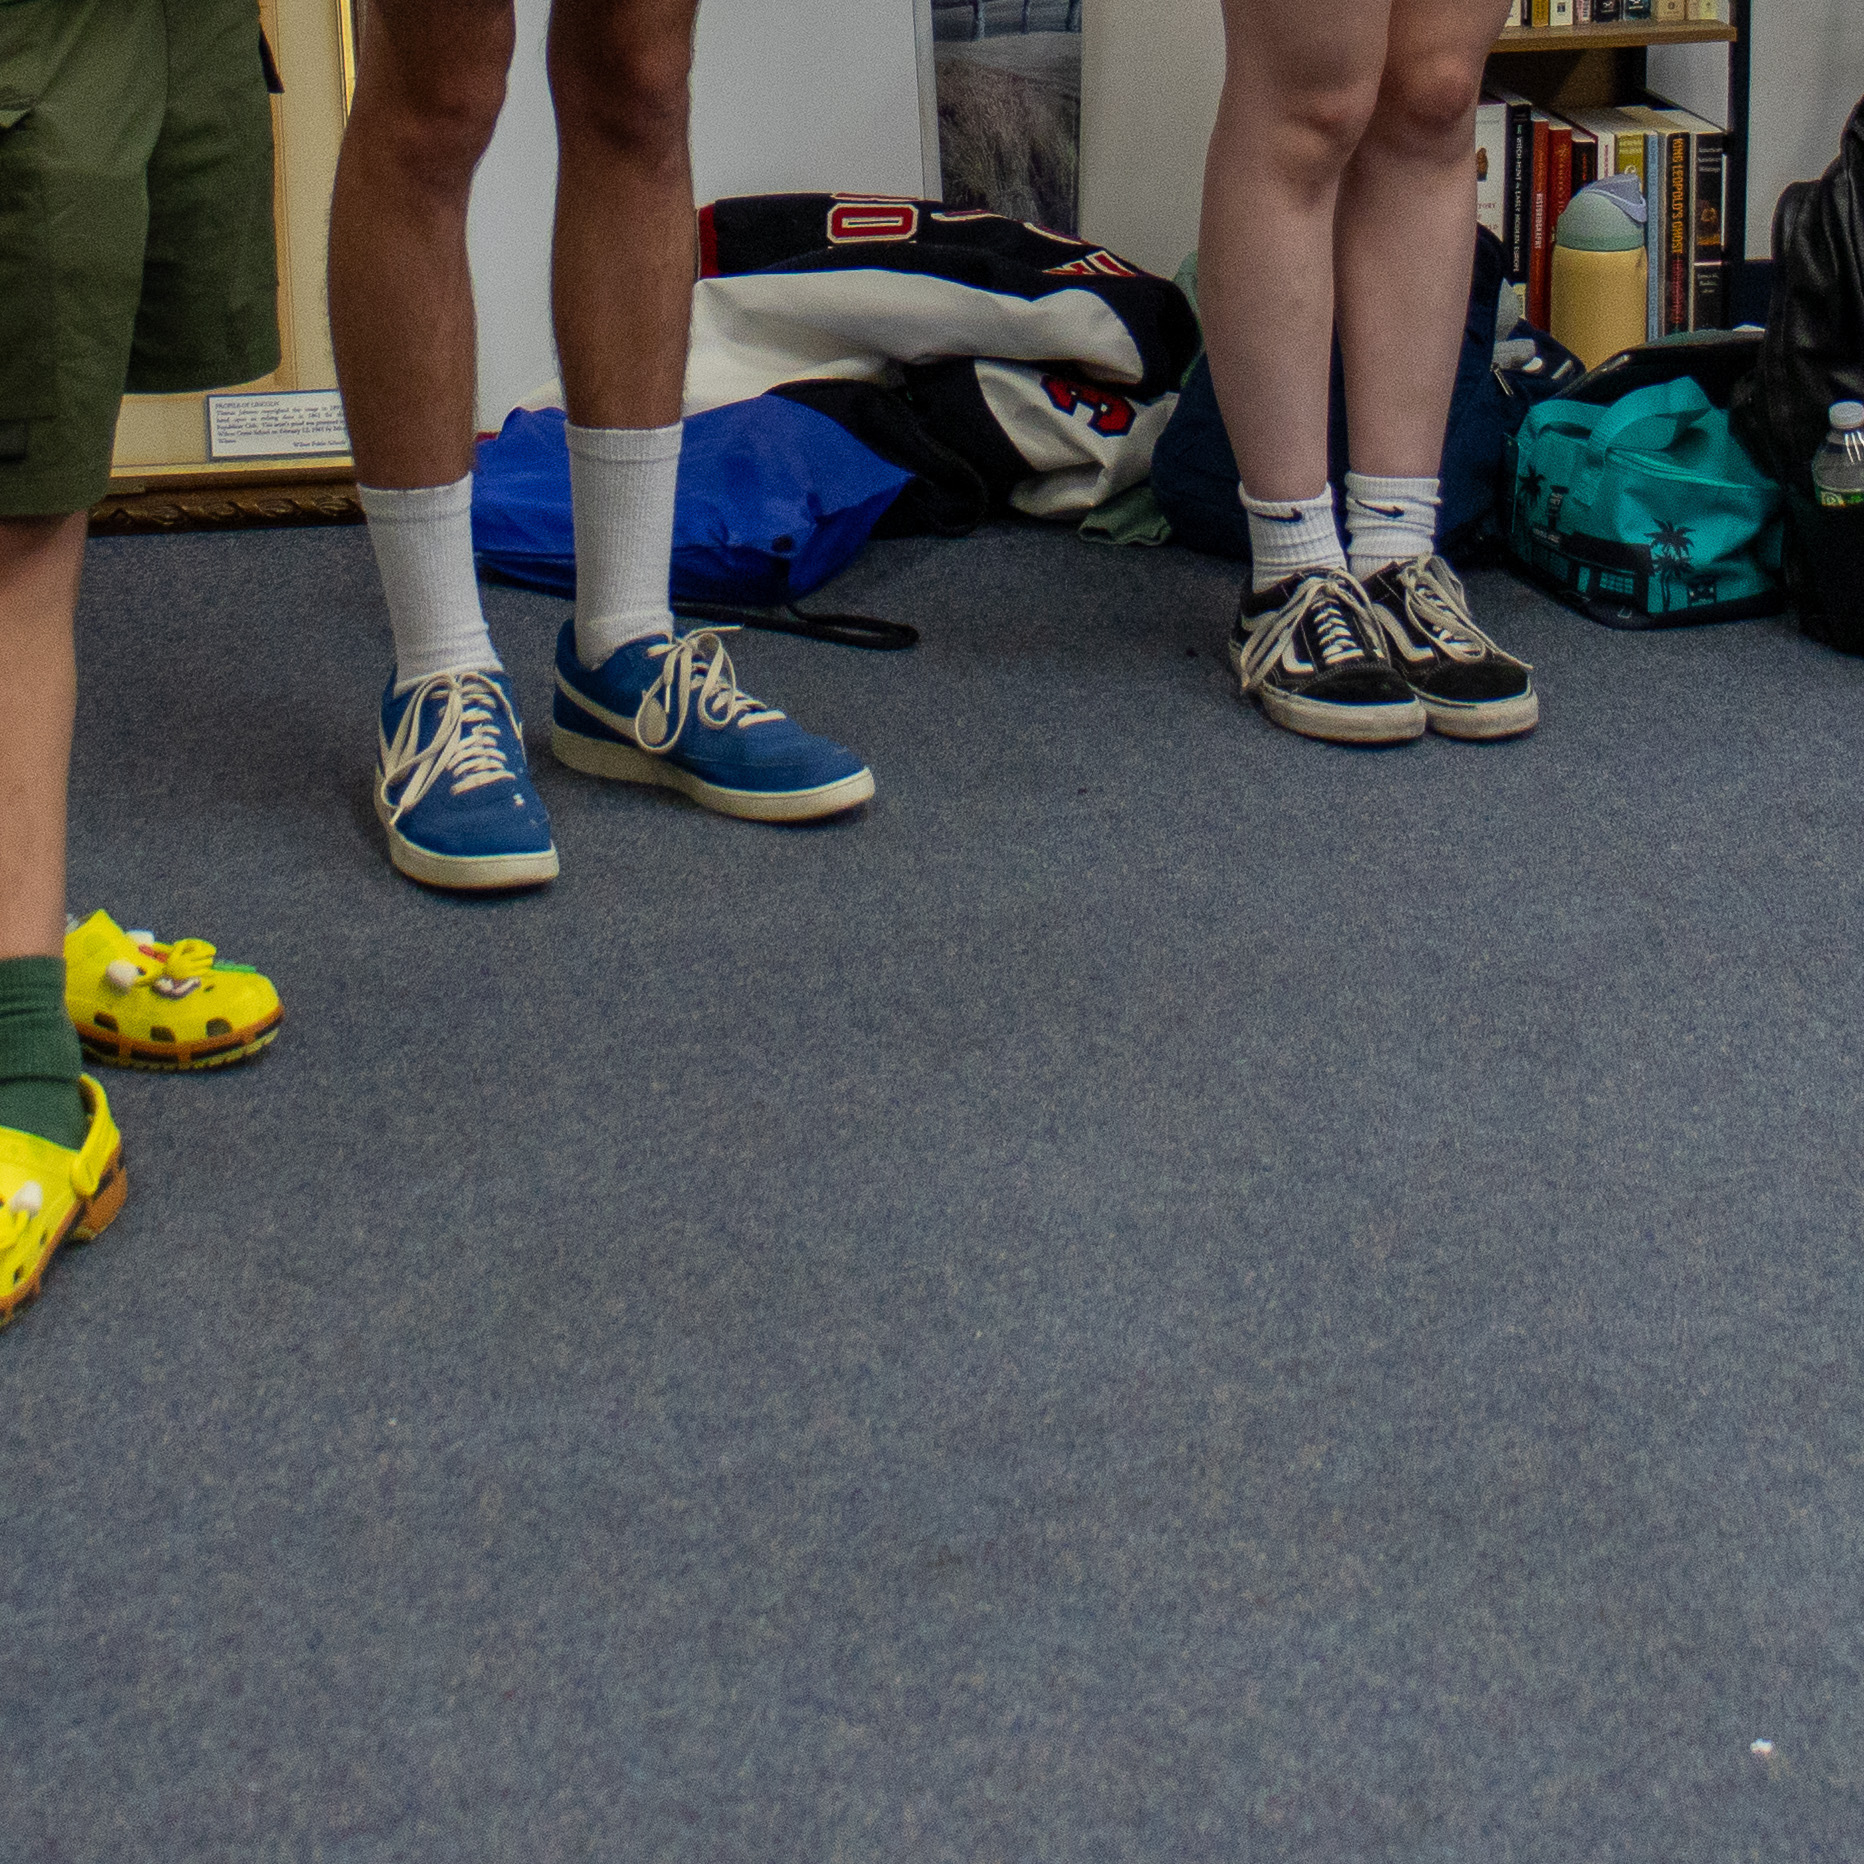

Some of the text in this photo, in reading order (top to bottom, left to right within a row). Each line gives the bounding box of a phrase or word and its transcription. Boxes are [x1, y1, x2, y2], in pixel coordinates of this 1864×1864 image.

[1672, 138, 1683, 163] KING
[1672, 165, 1683, 219] LEOPOLD'S
[1672, 221, 1683, 254] GHOST
